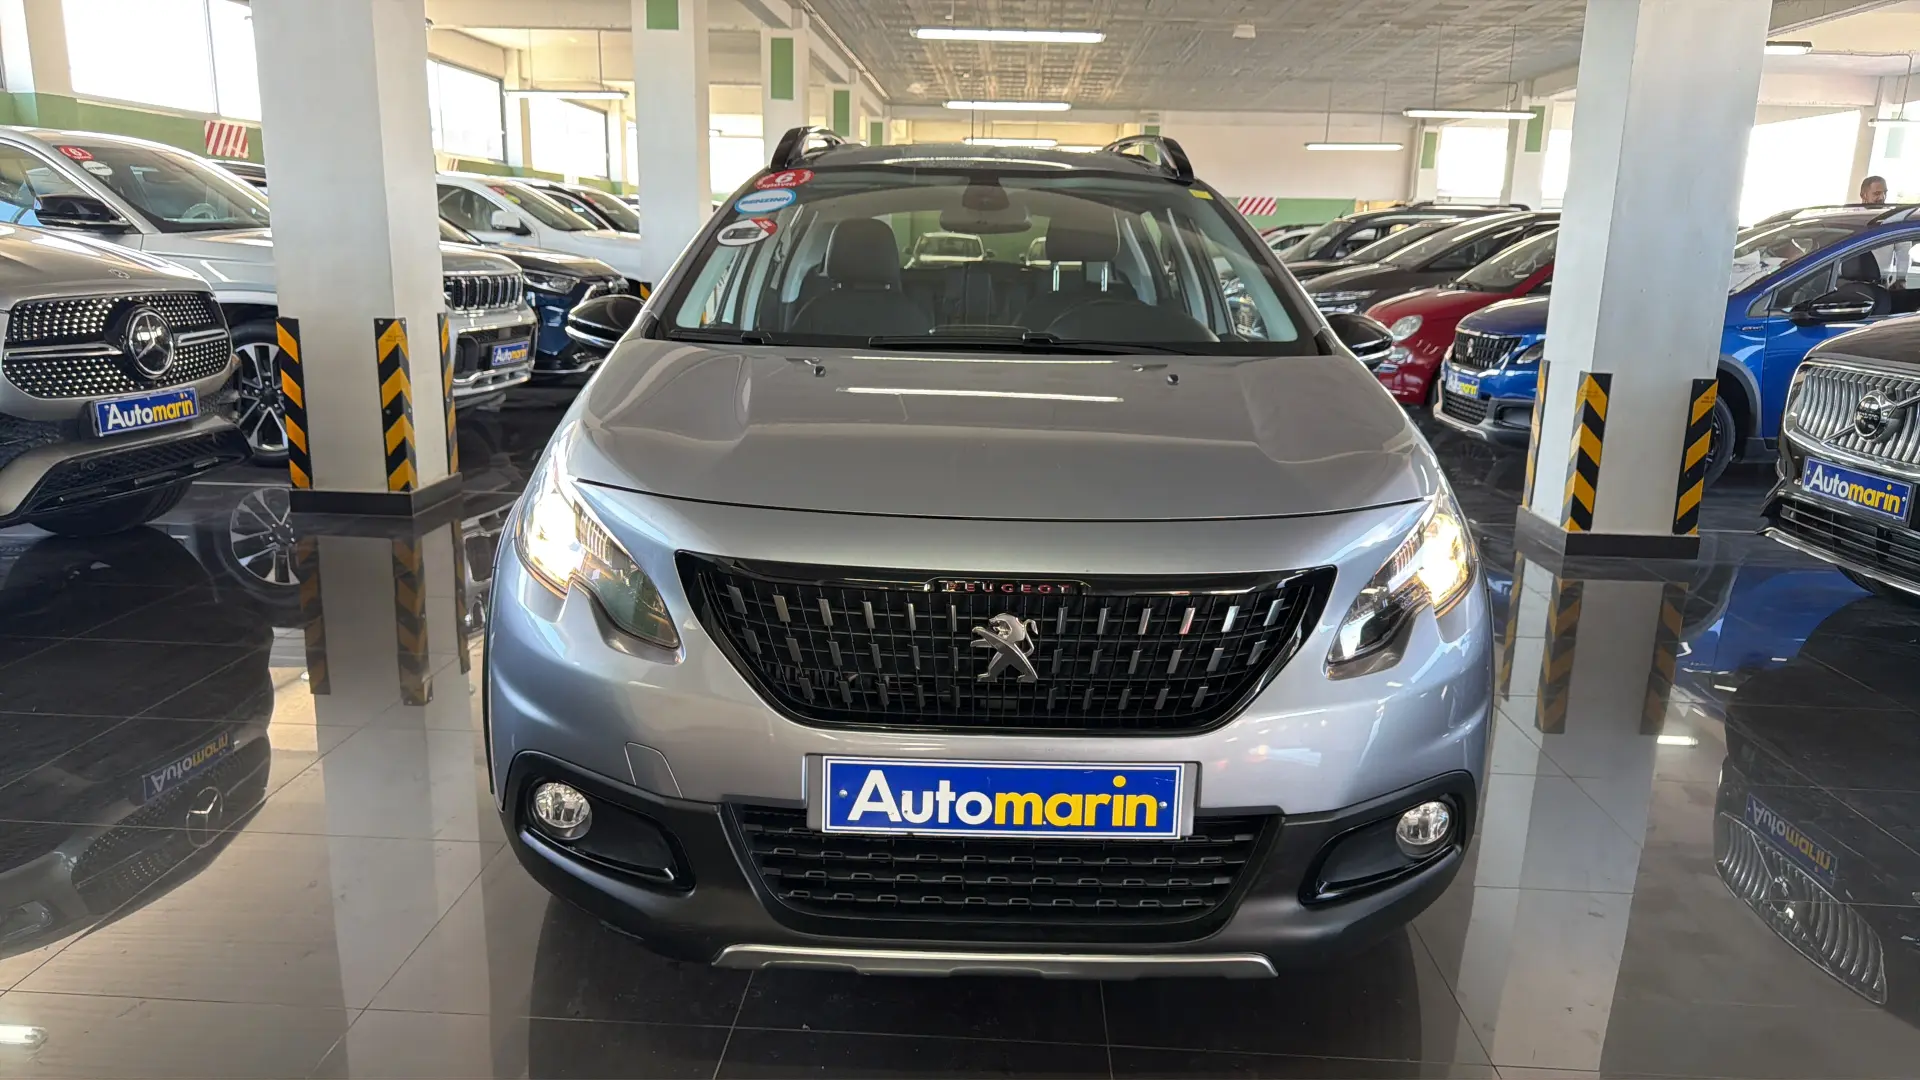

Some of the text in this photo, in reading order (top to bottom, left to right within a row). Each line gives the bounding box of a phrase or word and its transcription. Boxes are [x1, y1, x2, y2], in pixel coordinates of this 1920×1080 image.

[775, 172, 796, 183] 6
[107, 393, 194, 430] Automarin
[1809, 465, 1900, 514] Automarin
[946, 581, 1070, 593] PEUGEOT
[847, 769, 1157, 827] Automarin
